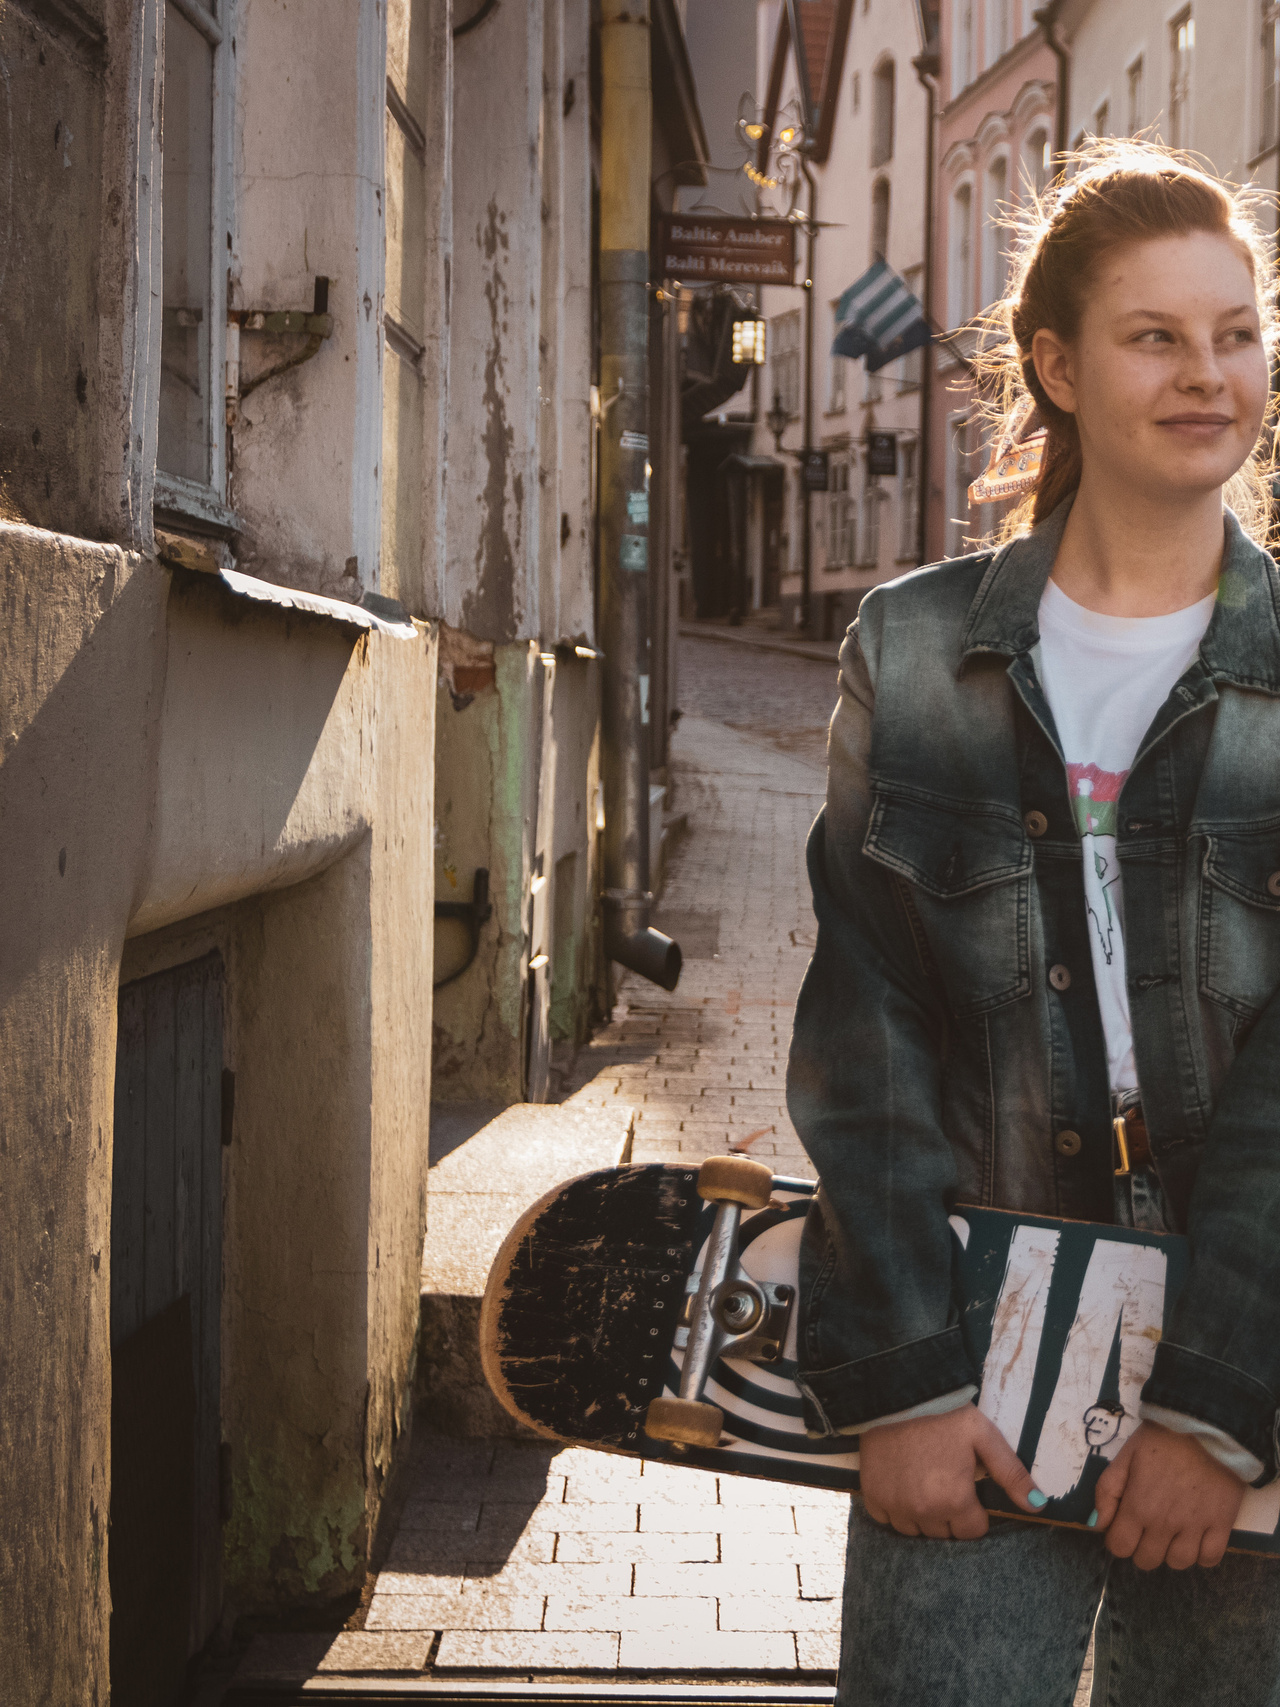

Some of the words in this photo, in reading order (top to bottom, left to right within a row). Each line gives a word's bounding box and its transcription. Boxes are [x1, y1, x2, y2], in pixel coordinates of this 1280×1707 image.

[671, 225, 722, 242] Baltic
[725, 229, 785, 245] Amber
[665, 255, 705, 270] Balti
[709, 258, 788, 275] Merevaik
